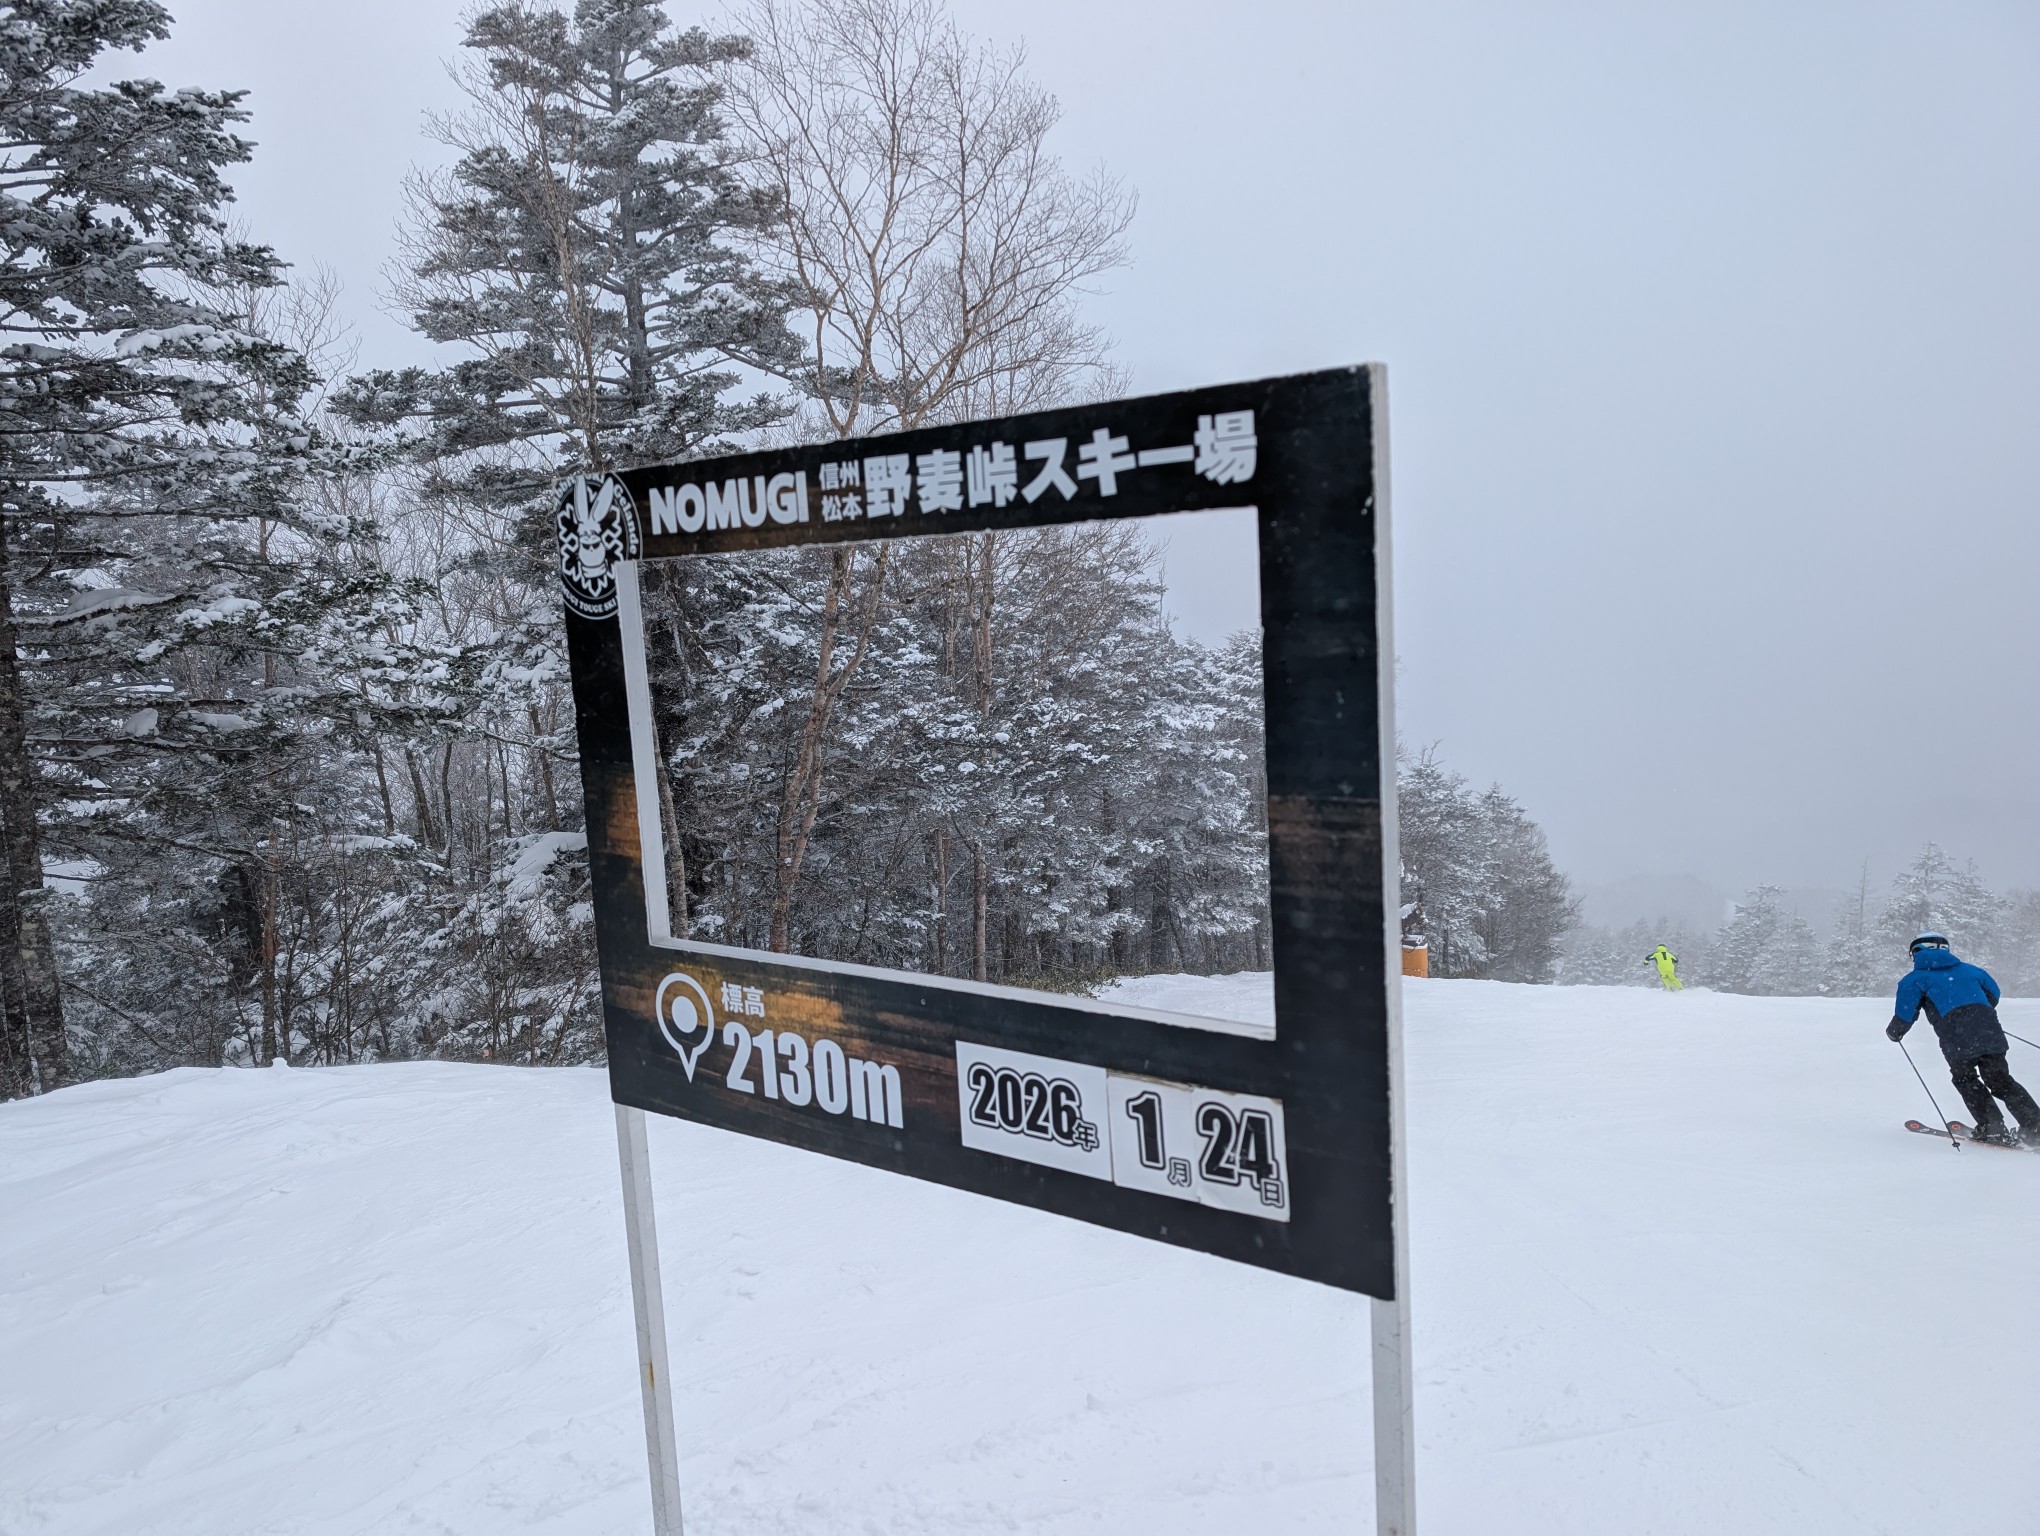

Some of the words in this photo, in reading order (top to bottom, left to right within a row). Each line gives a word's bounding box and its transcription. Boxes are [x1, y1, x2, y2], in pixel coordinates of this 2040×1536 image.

[819, 459, 860, 491] 信州
[863, 409, 1257, 519] 野麦峠スキー場
[649, 470, 809, 535] NOMUGI
[821, 492, 863, 523] 松本
[721, 981, 766, 1018] 標高
[723, 1021, 904, 1129] 2130m
[967, 1061, 1100, 1152] 2026年
[1126, 1091, 1192, 1188] 1月
[1196, 1102, 1285, 1208] 24日
